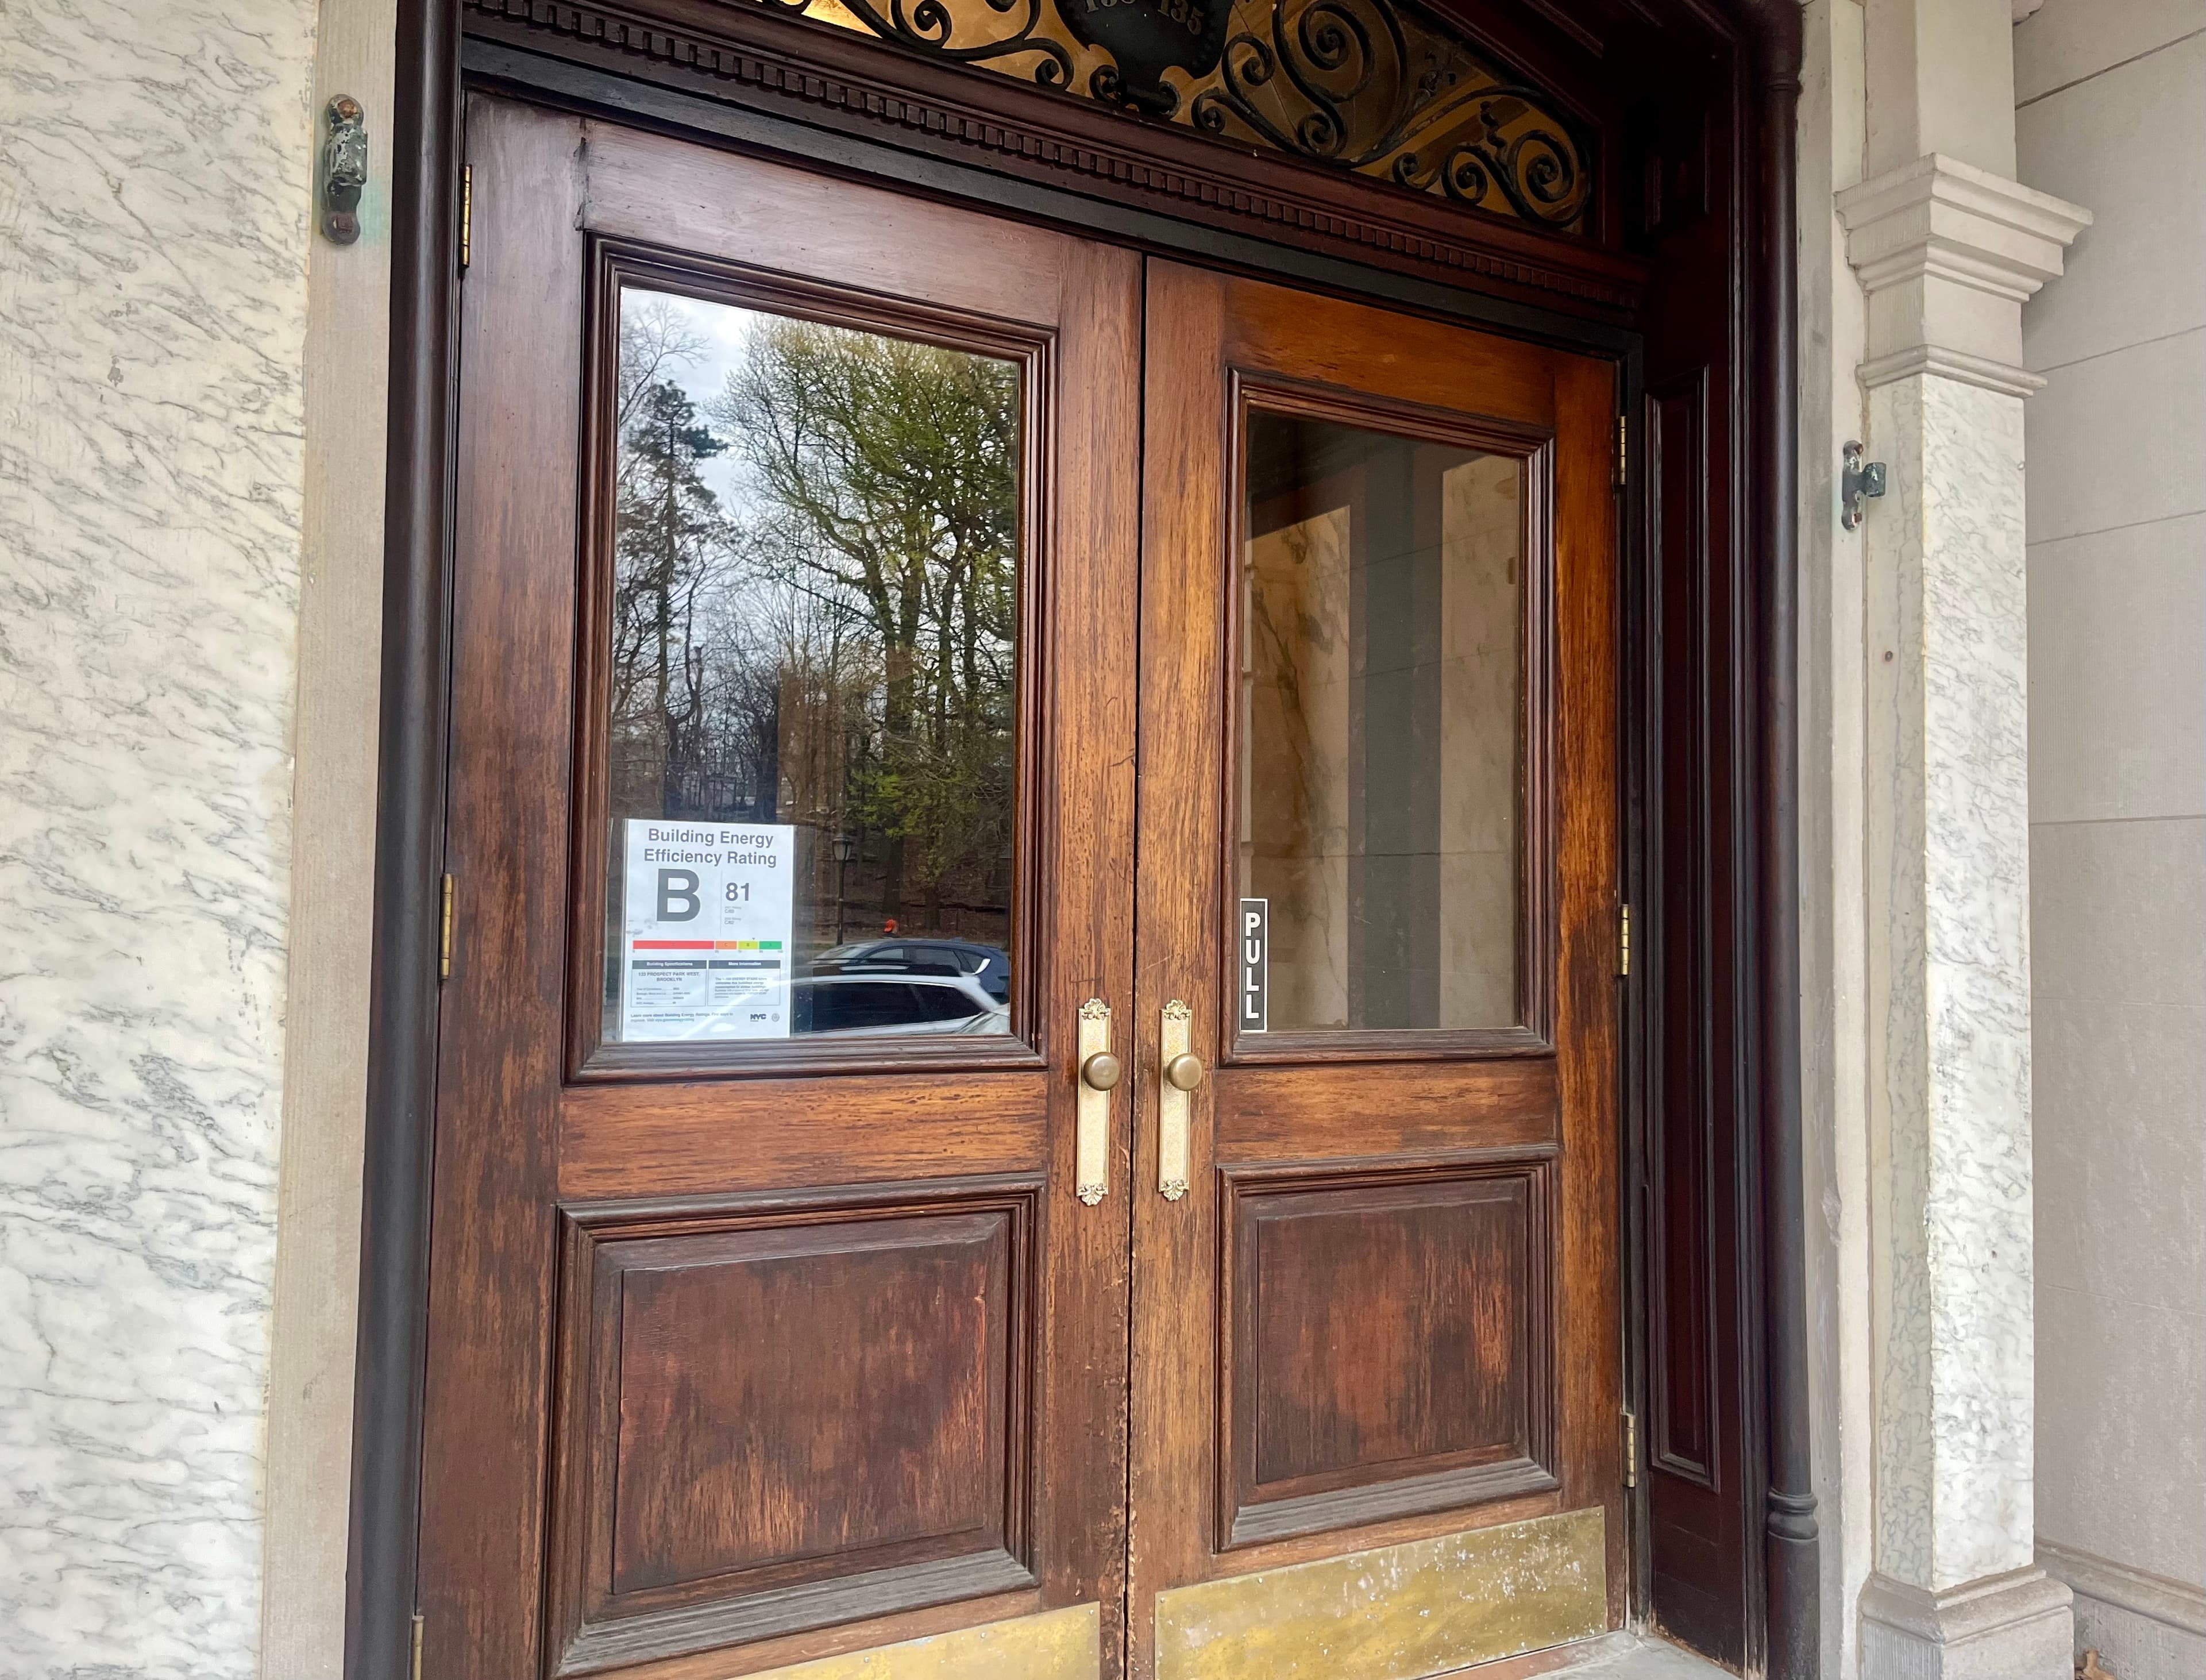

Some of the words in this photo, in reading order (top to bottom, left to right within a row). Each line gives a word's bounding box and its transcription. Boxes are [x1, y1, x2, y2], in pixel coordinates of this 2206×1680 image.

[649, 828, 714, 846] Building
[720, 831, 774, 848] Energy
[644, 849, 722, 866] Efficiency
[727, 851, 777, 868] Rating
[657, 868, 701, 922] B
[725, 882, 749, 901] 81
[1245, 912, 1261, 1019] PULL
